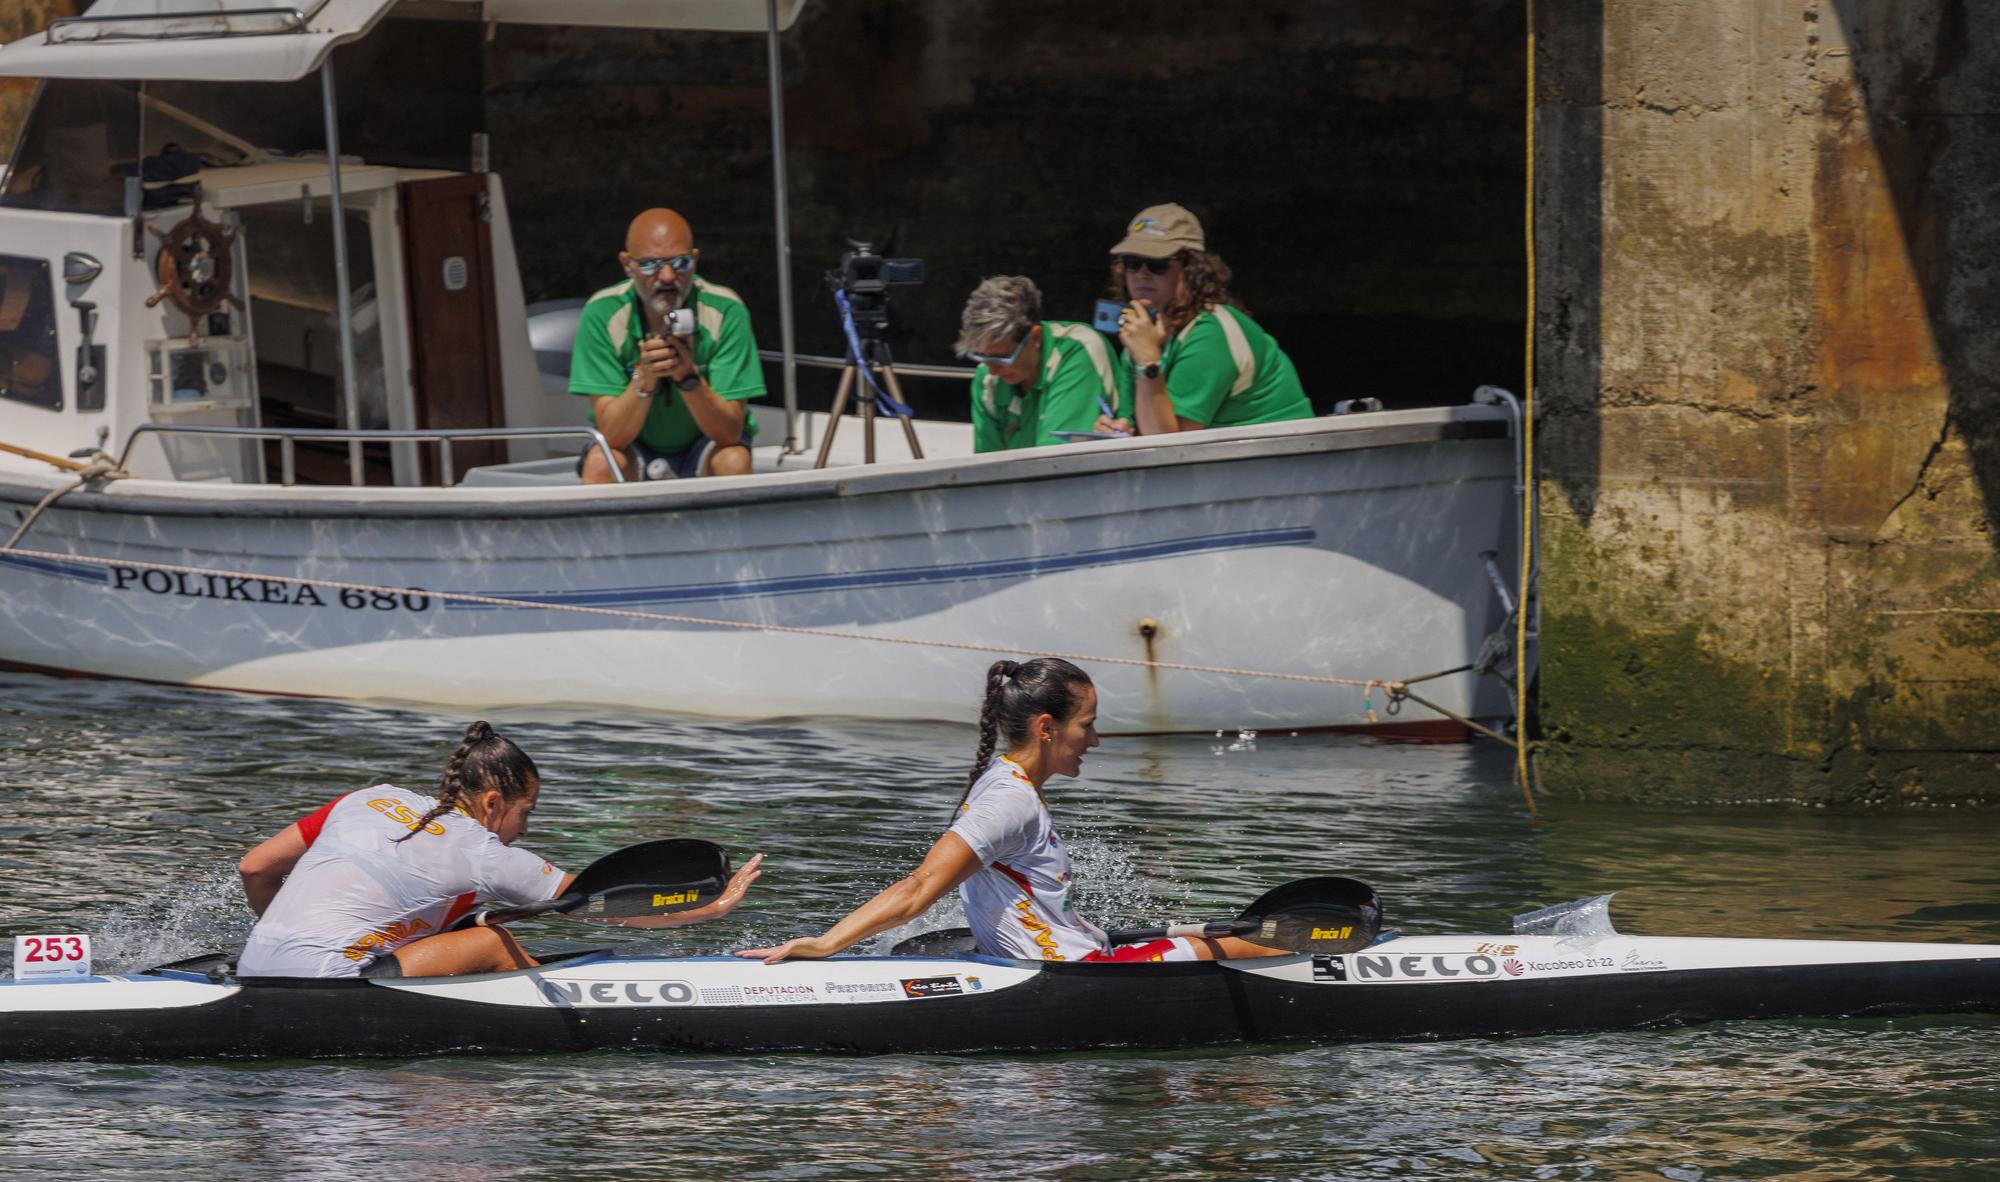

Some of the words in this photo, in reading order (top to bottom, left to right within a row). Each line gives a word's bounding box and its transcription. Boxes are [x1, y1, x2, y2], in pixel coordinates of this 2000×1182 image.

[109, 565, 327, 607] POLIKEA
[339, 585, 430, 612] 680
[367, 798, 446, 836] ESP
[24, 937, 84, 962] 253
[1356, 955, 1497, 978] NELO
[1527, 958, 1584, 971] Xacobeo
[1586, 957, 1614, 968] 21-22
[543, 981, 693, 1003] NELO
[743, 984, 815, 994] DEPUTACIÓN
